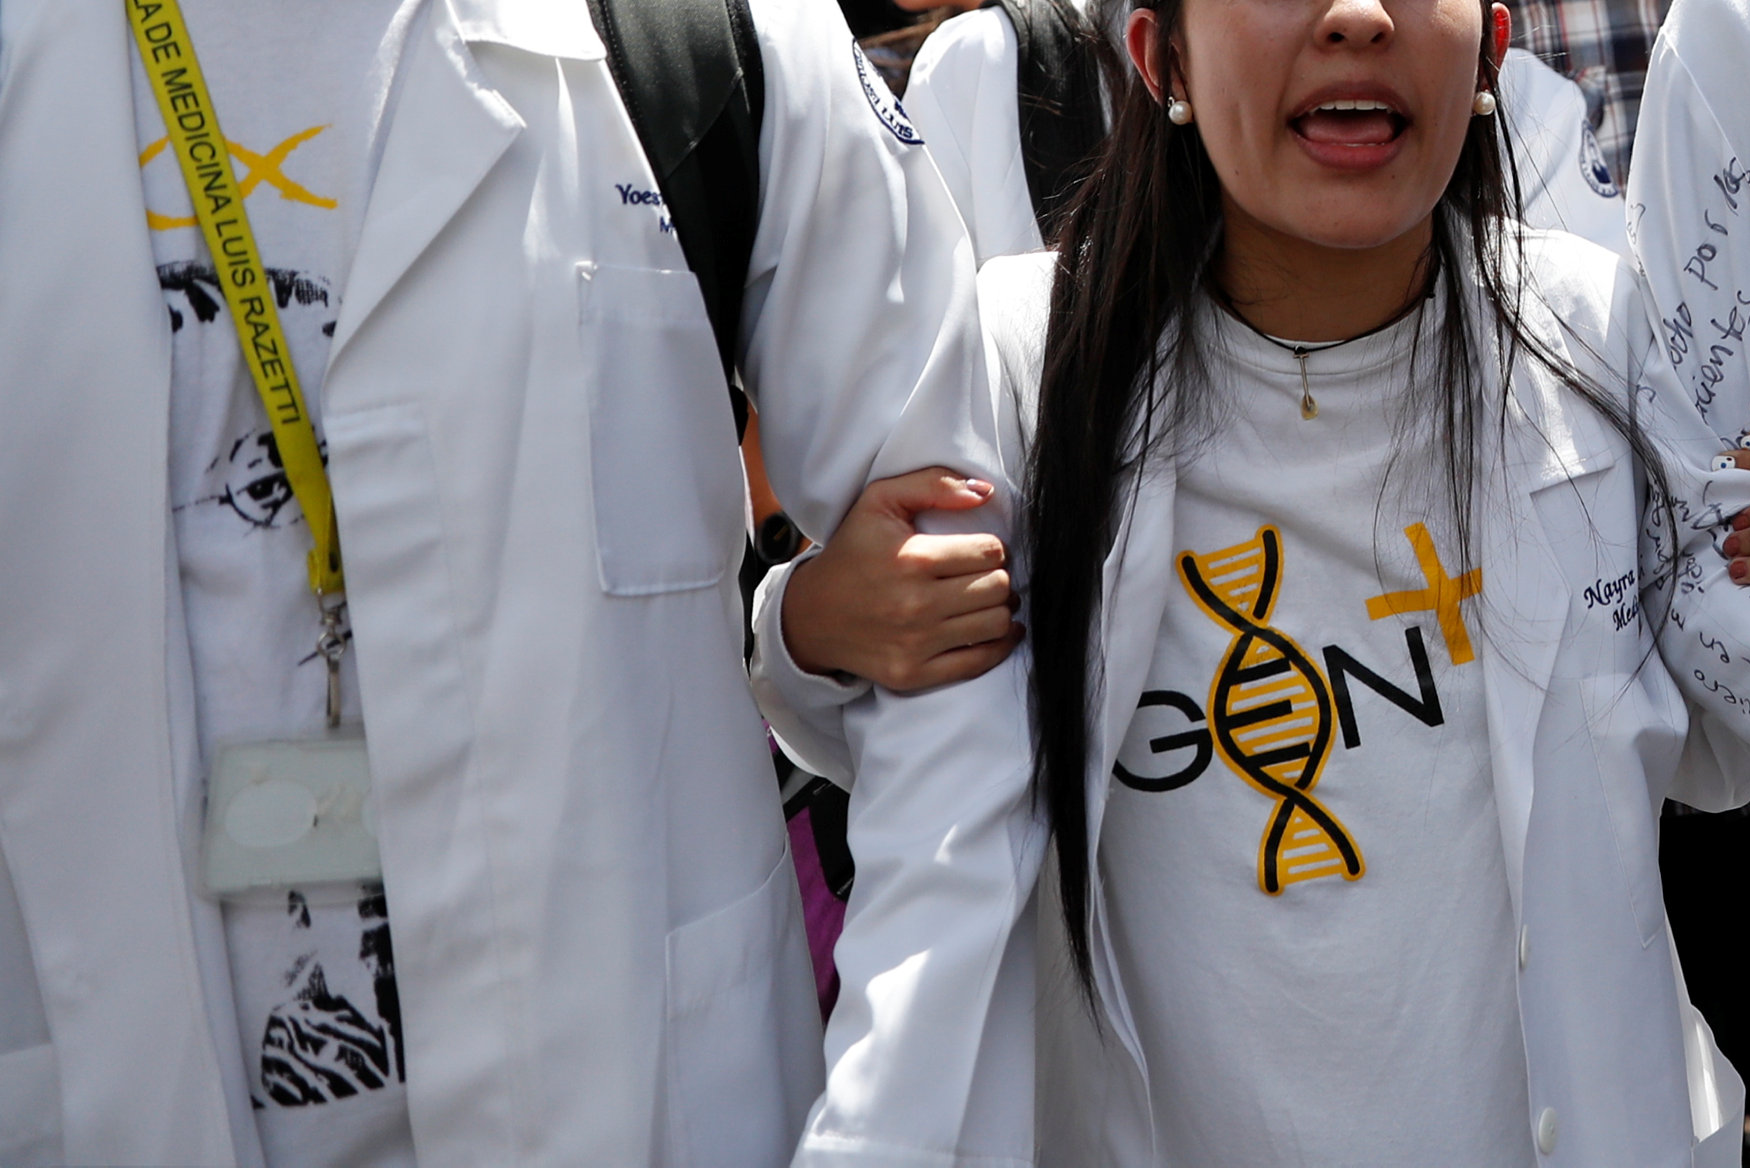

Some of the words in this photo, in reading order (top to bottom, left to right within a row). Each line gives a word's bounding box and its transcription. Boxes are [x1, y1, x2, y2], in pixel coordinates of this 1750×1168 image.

[144, 21, 181, 64] DE
[161, 67, 231, 215] MEDICINA
[215, 218, 255, 290] LUIS
[239, 295, 300, 424] RAZETTI
[1584, 569, 1636, 609] Nayra
